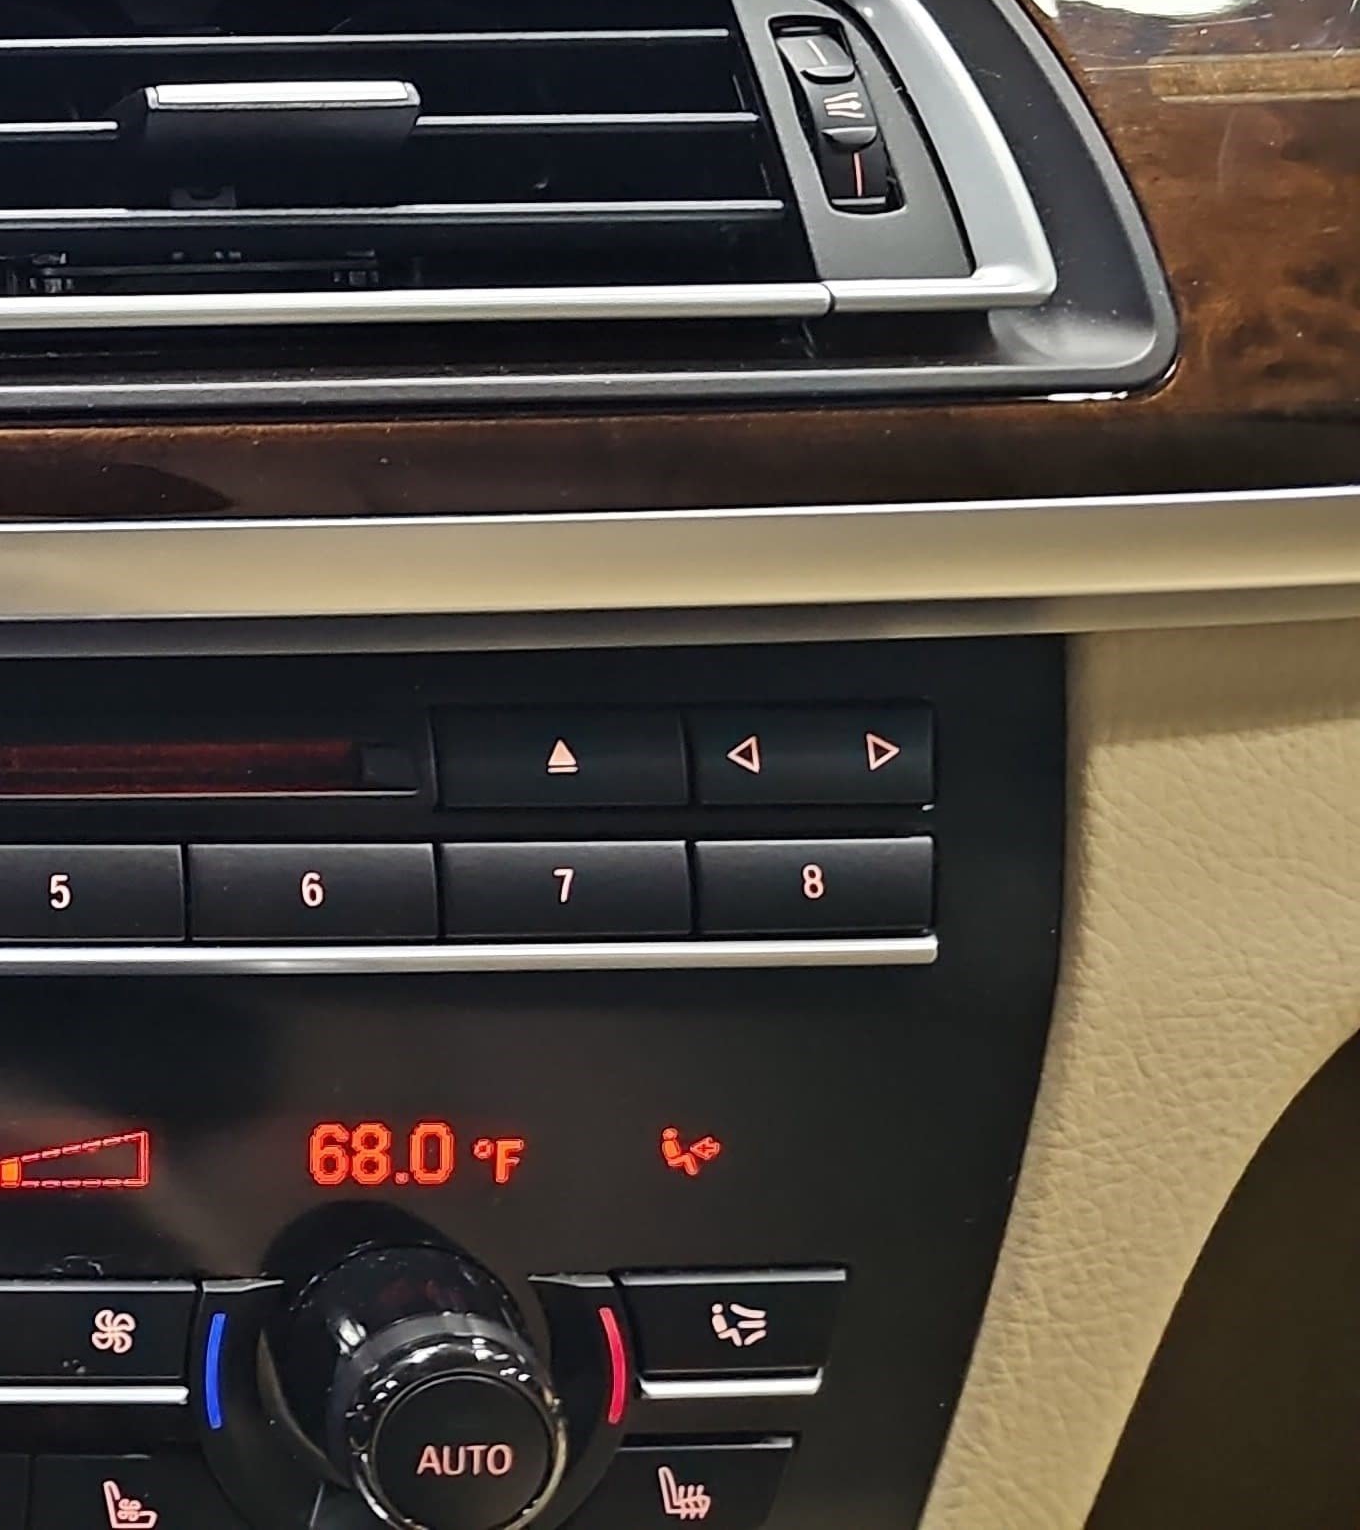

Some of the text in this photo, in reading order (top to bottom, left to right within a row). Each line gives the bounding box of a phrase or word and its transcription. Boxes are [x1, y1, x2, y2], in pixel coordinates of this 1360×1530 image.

[49, 874, 72, 910] 5
[300, 871, 324, 908] 6
[552, 867, 575, 903] 7
[801, 863, 825, 900] 8
[309, 1121, 454, 1185] 68.0
[416, 1443, 514, 1477] AUTO
